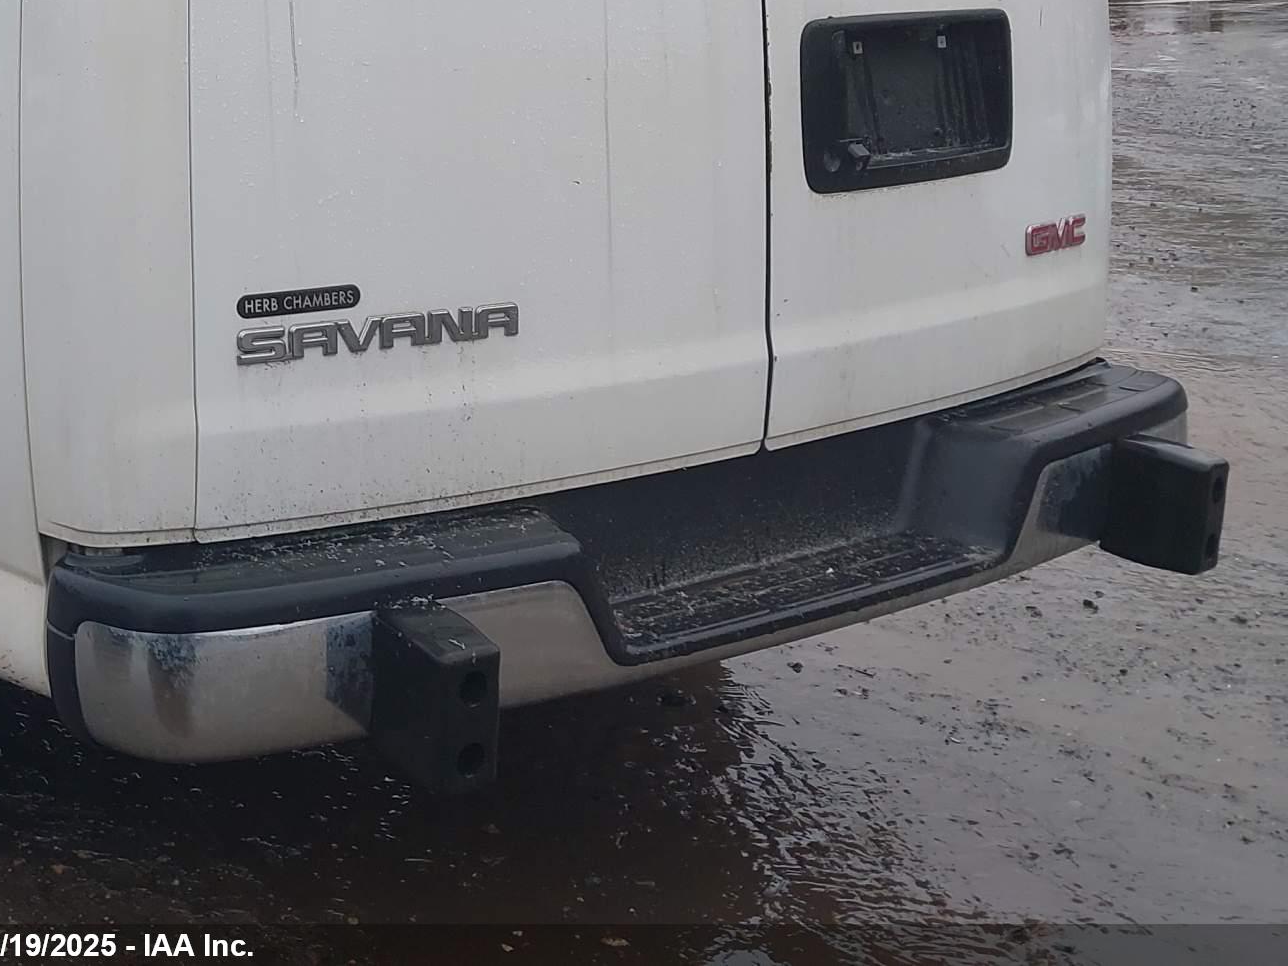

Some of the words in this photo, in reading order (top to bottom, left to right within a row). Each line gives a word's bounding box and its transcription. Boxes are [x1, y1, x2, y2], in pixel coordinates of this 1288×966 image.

[1025, 214, 1086, 256] GMC
[244, 298, 279, 314] HERB
[283, 290, 354, 310] CHAMBERS
[236, 302, 519, 366] SAVANA
